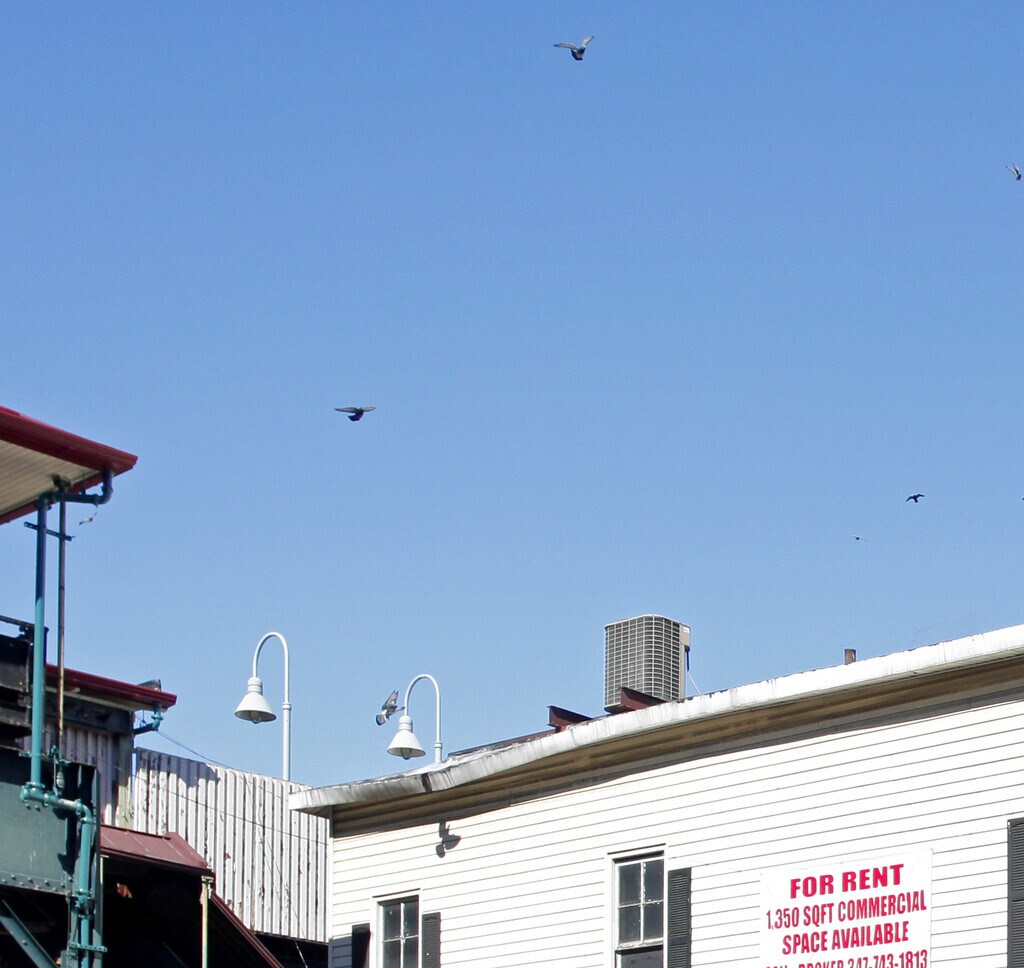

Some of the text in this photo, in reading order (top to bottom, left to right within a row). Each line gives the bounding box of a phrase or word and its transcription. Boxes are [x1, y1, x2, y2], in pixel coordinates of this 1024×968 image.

[790, 863, 904, 899] FOR RENT
[766, 889, 927, 930] 1,350 SQFT COMMERCIAL
[782, 921, 909, 955] SPACE AVAILABLE
